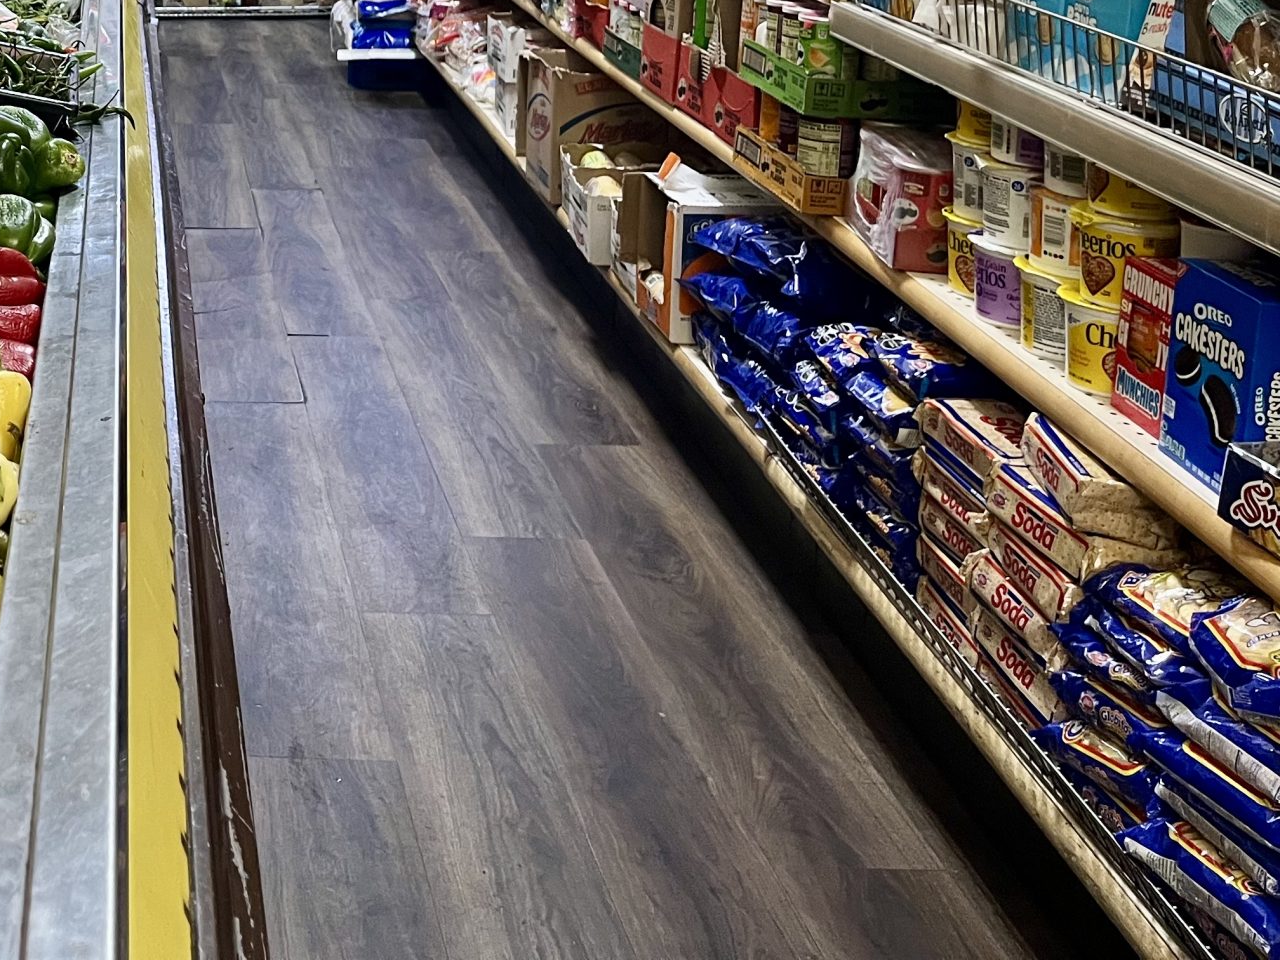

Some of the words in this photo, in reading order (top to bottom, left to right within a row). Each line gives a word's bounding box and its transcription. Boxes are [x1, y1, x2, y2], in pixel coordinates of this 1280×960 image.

[1123, 264, 1175, 315] CRUNCHY
[1194, 302, 1234, 328] OREO
[1175, 312, 1246, 381] CAKESTERS
[1117, 365, 1160, 419] MUNCHIES
[1254, 386, 1266, 426] OREO
[942, 425, 975, 467] Soda
[1035, 445, 1061, 493] Soda
[942, 521, 976, 554] Soda
[1011, 501, 1055, 552] Soda
[1002, 542, 1039, 594] Soda
[991, 583, 1030, 632] Soda
[995, 636, 1036, 691] Soda
